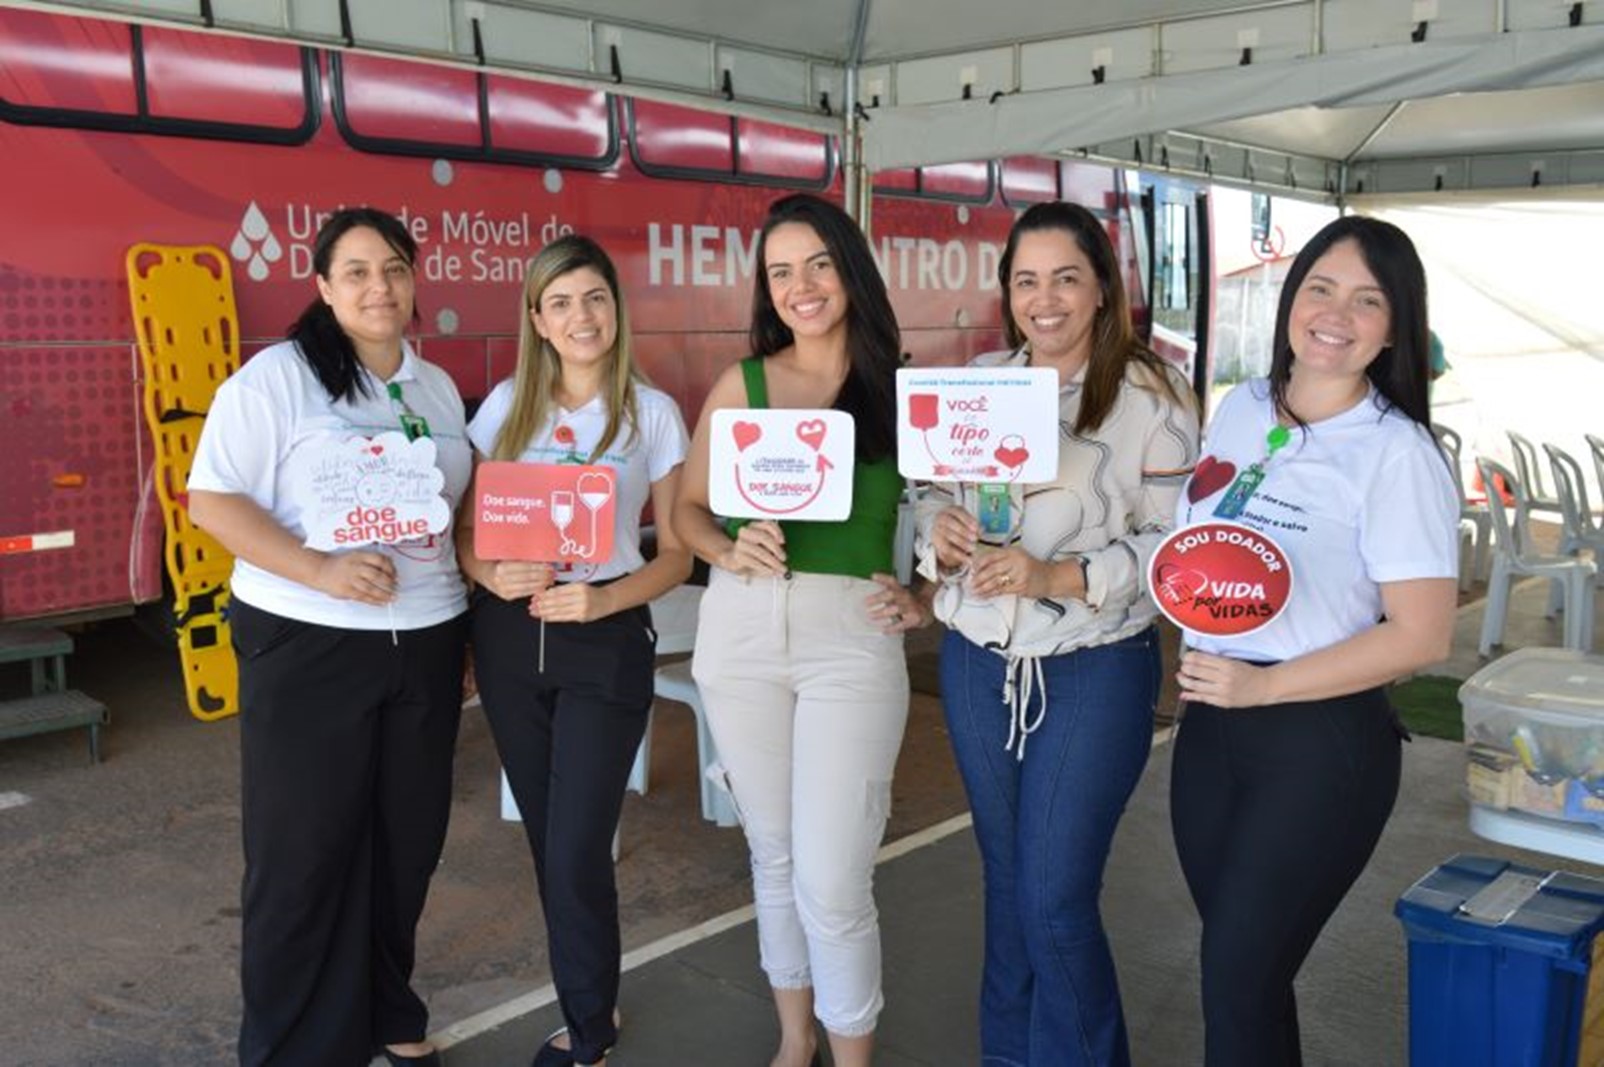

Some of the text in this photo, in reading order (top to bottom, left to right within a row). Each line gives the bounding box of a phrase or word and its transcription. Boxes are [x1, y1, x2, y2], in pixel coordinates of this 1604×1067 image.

[443, 211, 529, 246] Móvel
[425, 245, 461, 281] de
[946, 396, 988, 411] VOCÊ
[950, 423, 989, 445] tipo
[482, 494, 546, 511] Doe sangue.
[347, 506, 396, 526] doe
[482, 511, 504, 523] Doe
[334, 518, 428, 544] sangue
[1174, 530, 1282, 573] SOU DOADOR
[1211, 581, 1266, 600] VIDA
[1193, 596, 1222, 610] por
[1209, 603, 1274, 619] VIDAS
